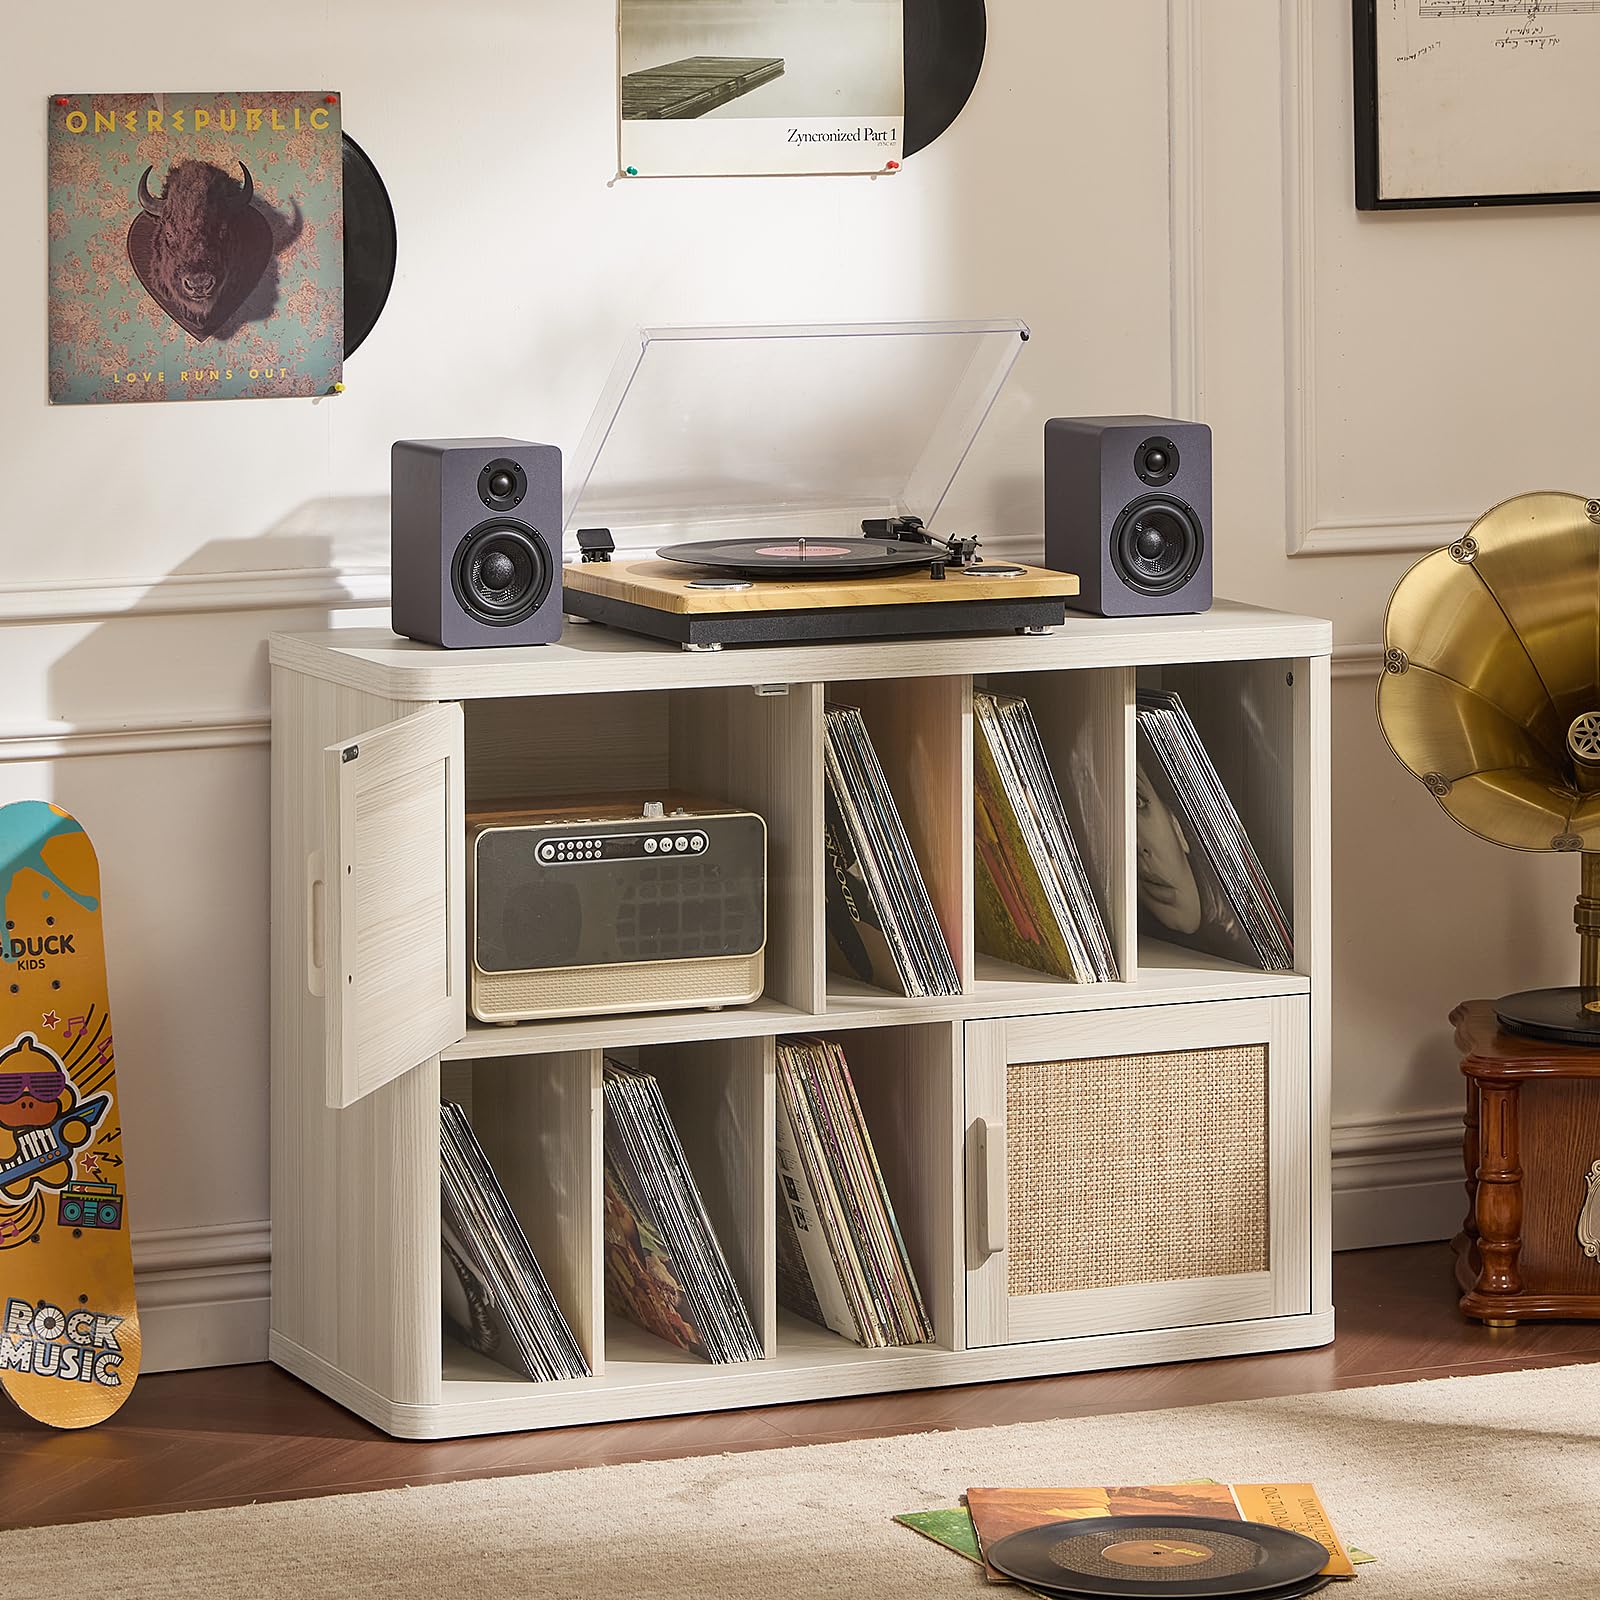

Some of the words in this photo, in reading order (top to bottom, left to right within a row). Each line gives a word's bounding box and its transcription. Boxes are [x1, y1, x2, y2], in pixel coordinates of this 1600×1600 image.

[65, 107, 329, 133] ONEREPUBLIC
[787, 128, 861, 147] Zyncronized
[864, 127, 887, 141] Part
[890, 128, 897, 141] 1
[113, 371, 165, 383] LOVE
[181, 369, 233, 381] RUNS
[249, 368, 287, 379] OUT
[830, 854, 860, 922] GIDON
[0, 934, 75, 958] .DUCK
[17, 959, 46, 971] KIDS
[5, 1298, 123, 1351] ROCK
[0, 1334, 124, 1387] MUSIC
